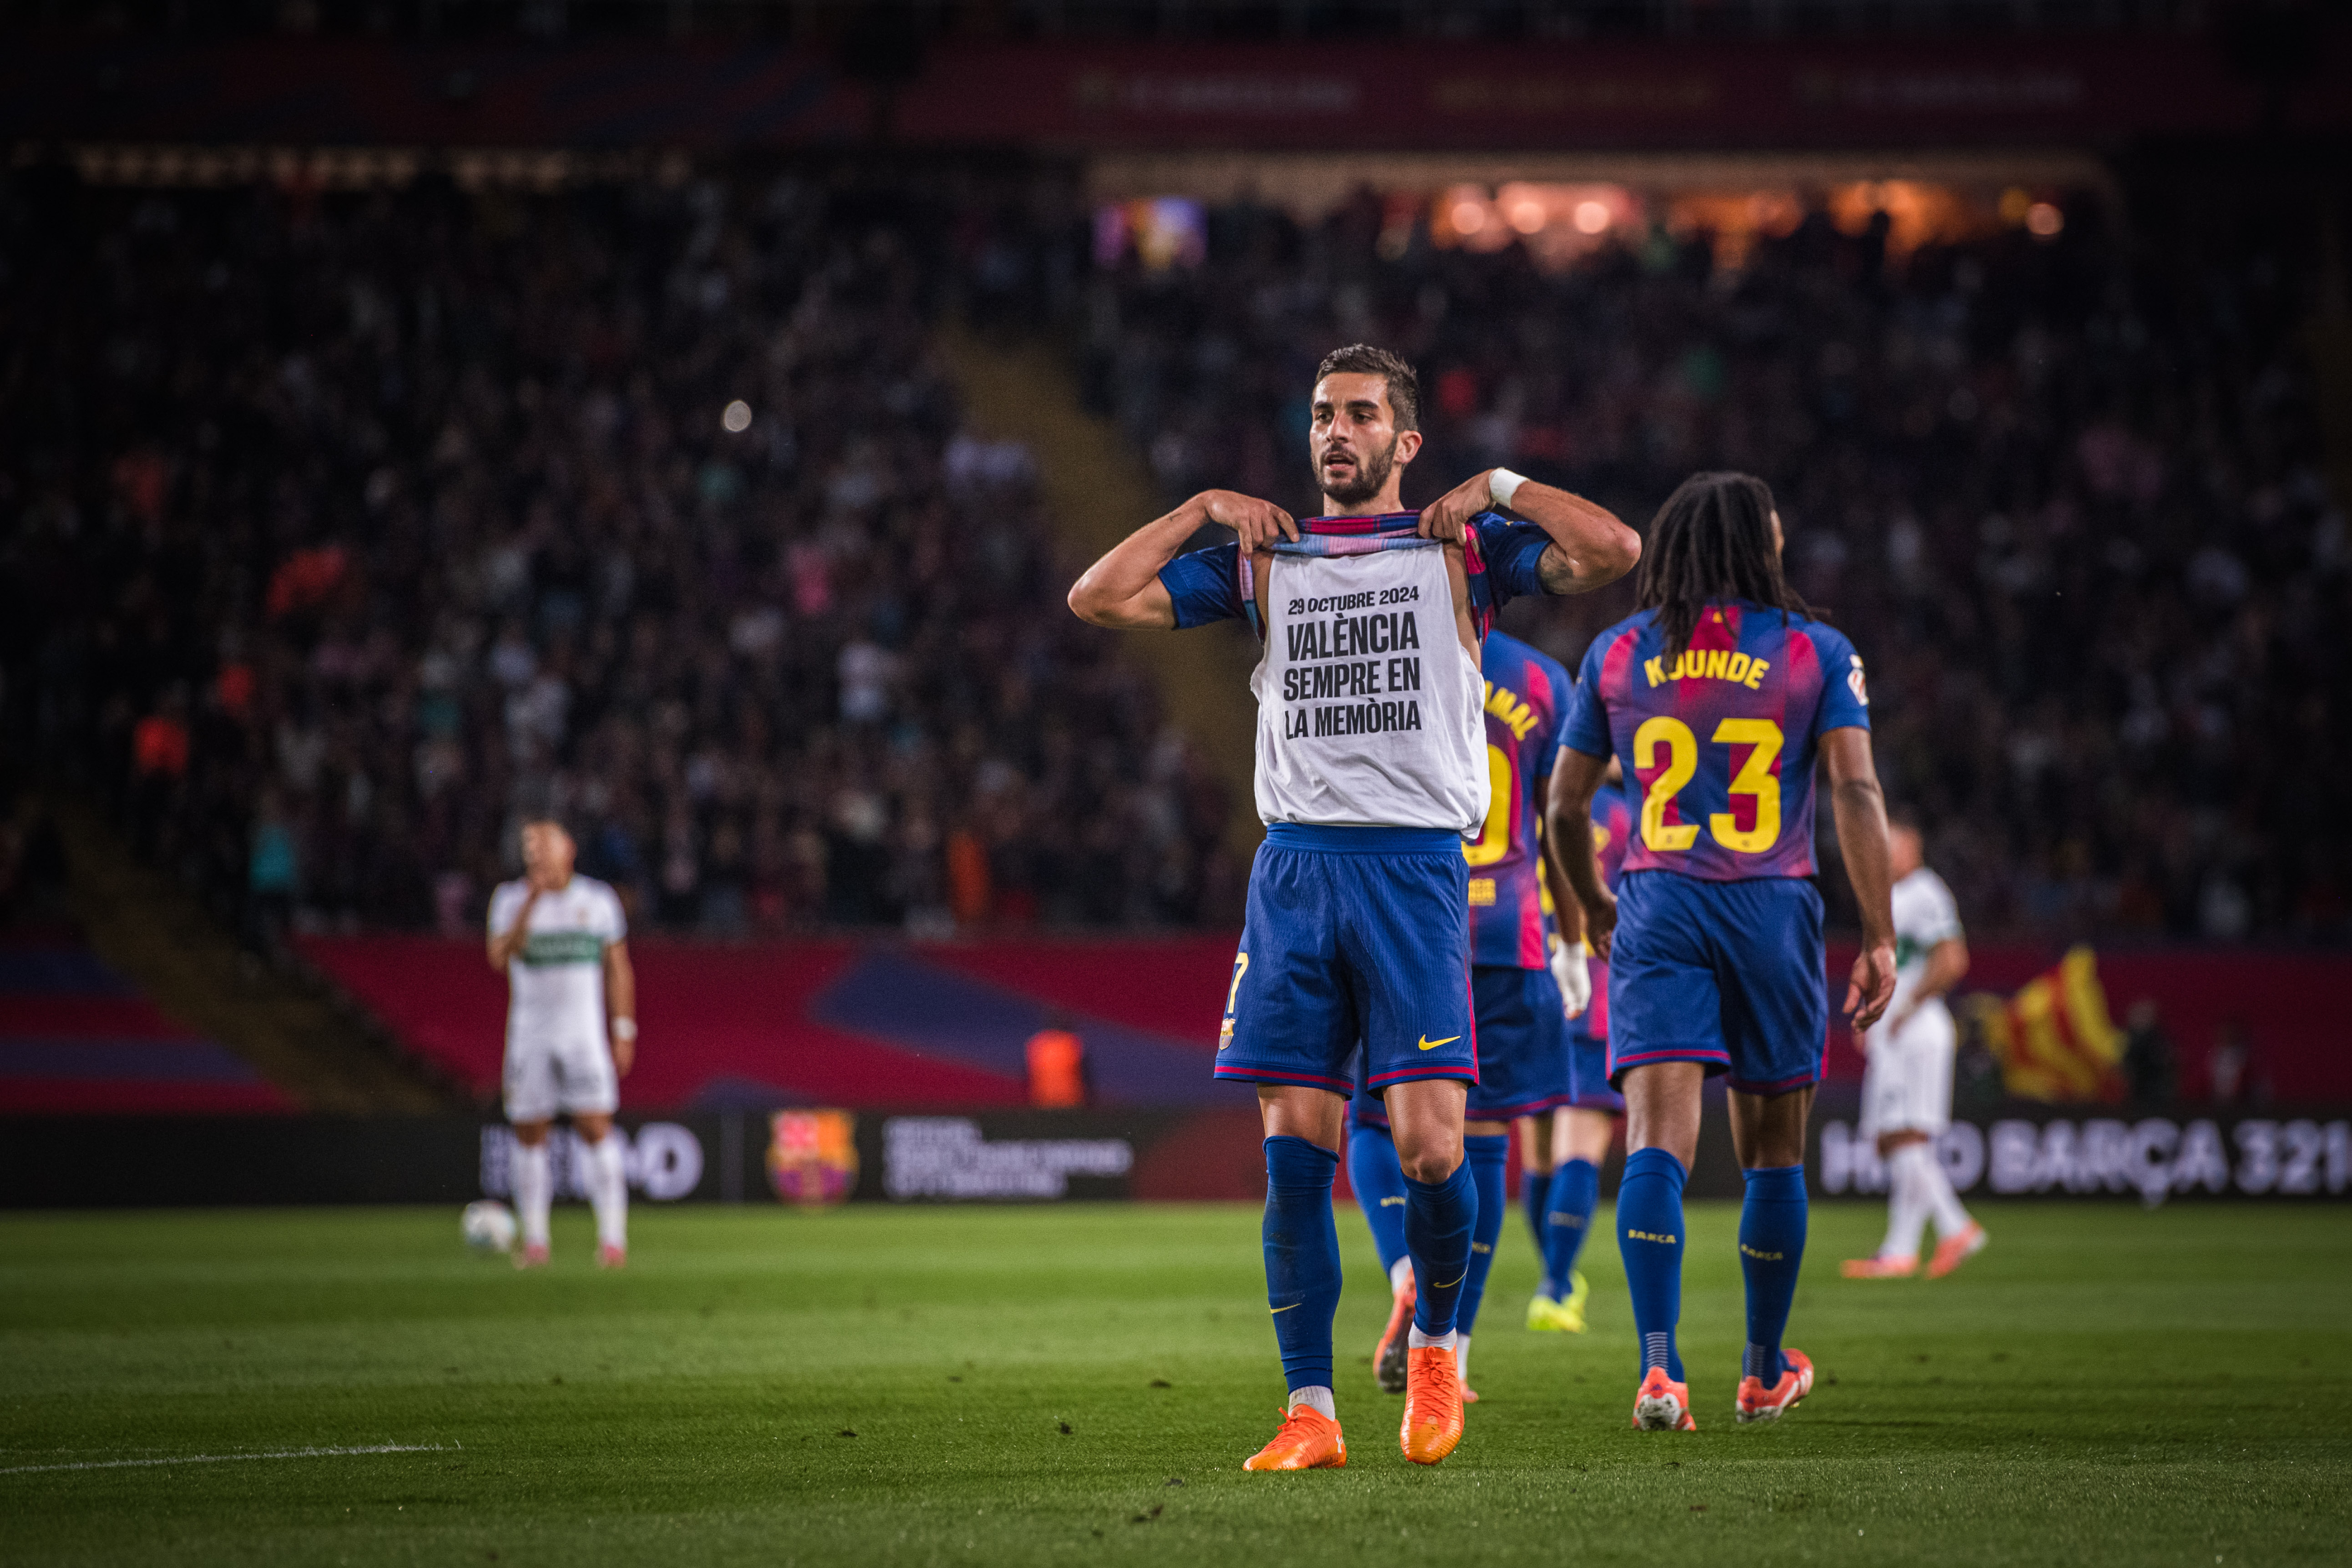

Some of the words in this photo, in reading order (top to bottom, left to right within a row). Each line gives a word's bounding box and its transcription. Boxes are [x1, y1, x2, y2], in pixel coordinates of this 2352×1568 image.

[1288, 598, 1305, 615] 29
[1307, 591, 1375, 612] OCTUBRE
[1379, 586, 1419, 606] 2024
[1287, 611, 1420, 661] VALÈNCIA
[1283, 661, 1381, 701] SEMPRE
[1388, 657, 1421, 692] EN
[1285, 709, 1309, 740] LA
[1315, 698, 1422, 737] MEMÒRIA
[1633, 716, 1784, 854] 23
